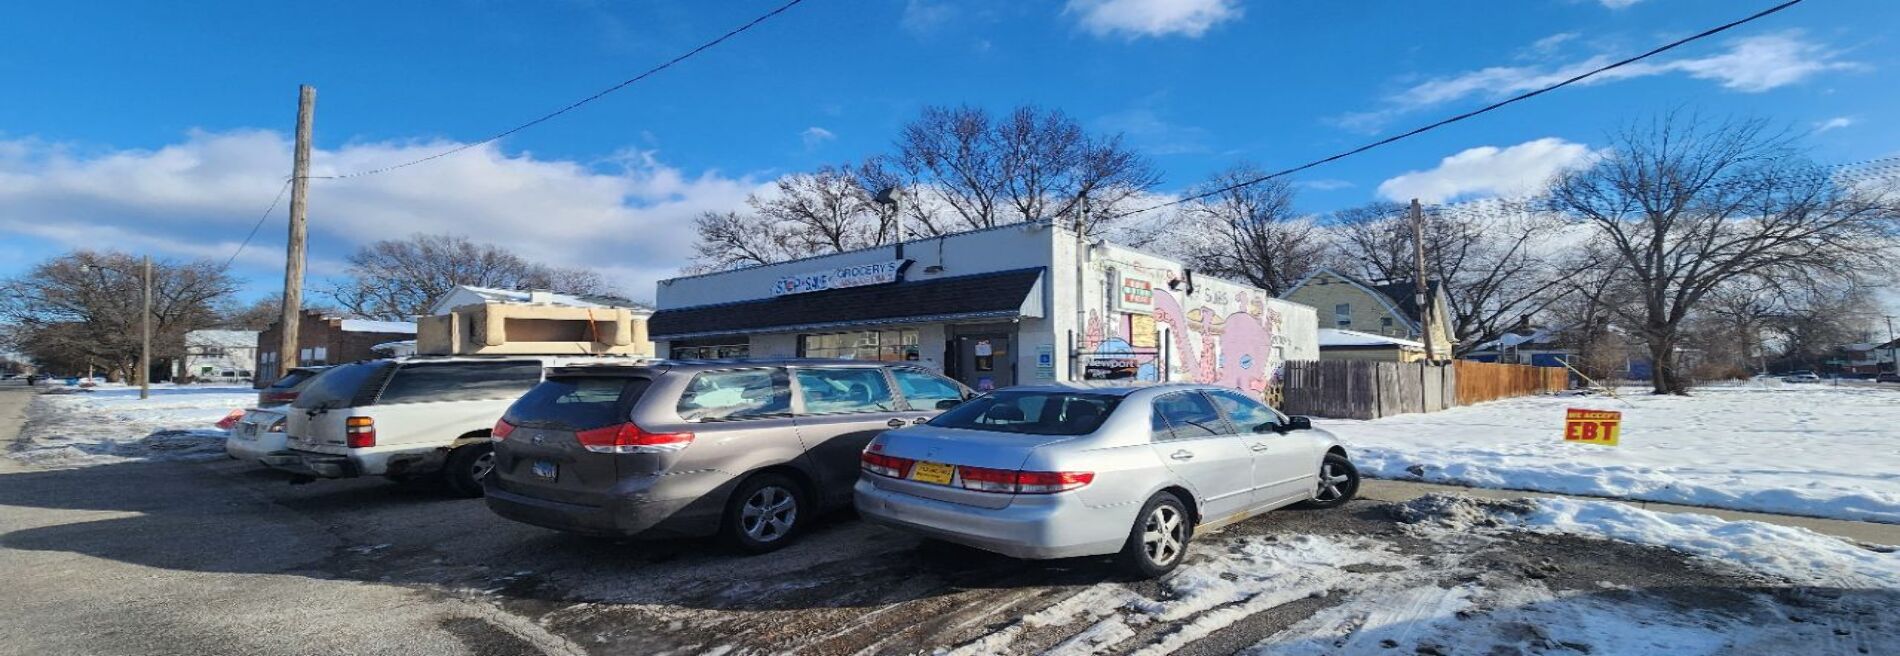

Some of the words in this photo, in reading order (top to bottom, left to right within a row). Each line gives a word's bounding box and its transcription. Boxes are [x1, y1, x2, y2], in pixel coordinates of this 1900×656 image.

[1083, 358, 1138, 370] Newport
[1584, 412, 1619, 420] ACCEPT
[1566, 422, 1617, 440] EBT
